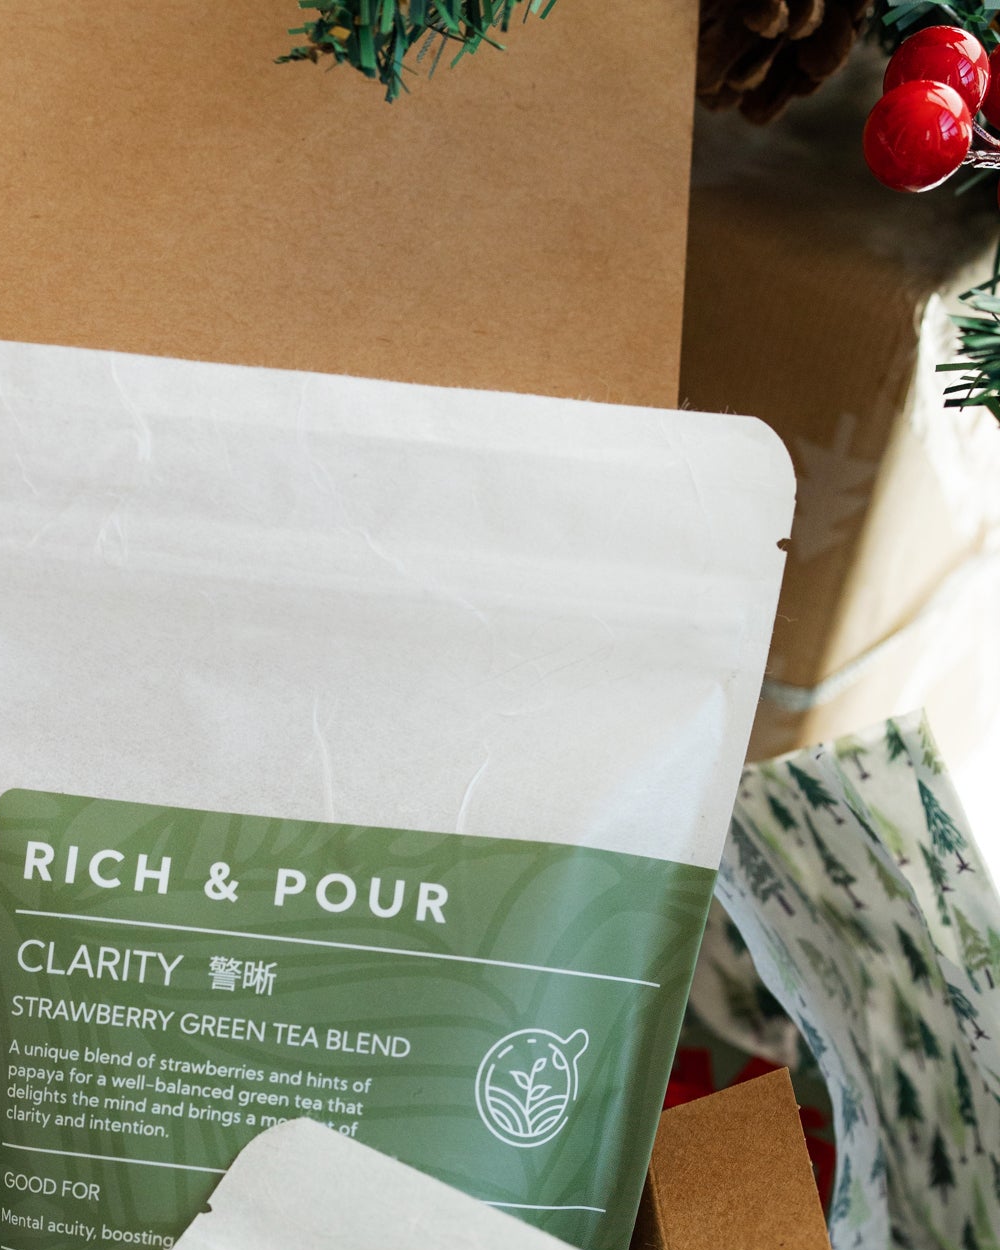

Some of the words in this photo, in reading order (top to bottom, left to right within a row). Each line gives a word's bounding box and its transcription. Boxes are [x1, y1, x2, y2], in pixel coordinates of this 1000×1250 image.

[23, 840, 172, 895] RICH
[204, 861, 240, 903] &
[273, 867, 449, 924] POUR
[16, 938, 185, 987] CLARITY
[208, 955, 278, 996] 警晰
[11, 994, 176, 1032] STRAWBERRY
[179, 1012, 266, 1042] GREEN
[272, 1022, 319, 1049] TEA
[325, 1028, 411, 1058] BLEND
[8, 1039, 20, 1054] A
[24, 1043, 79, 1063] unique
[84, 1047, 133, 1067] blend
[136, 1053, 156, 1068] of
[160, 1057, 264, 1082] strawberries
[269, 1071, 302, 1086] and
[306, 1072, 348, 1092] hints
[352, 1078, 373, 1093] of
[8, 1064, 64, 1083] papaya
[69, 1068, 93, 1084] for
[97, 1075, 107, 1086] a
[112, 1074, 235, 1101] well-balanced
[238, 1090, 289, 1107] green
[295, 1095, 323, 1110] tea
[328, 1097, 364, 1116] that
[6, 1105, 51, 1128] clarity
[55, 1113, 85, 1129] and
[90, 1115, 170, 1138] intention.
[7, 1083, 67, 1105] delights
[72, 1091, 100, 1108] the
[104, 1095, 147, 1113] mind
[151, 1102, 184, 1118] and
[188, 1103, 241, 1127] brings
[246, 1114, 256, 1126] a
[339, 1122, 359, 1137] of
[3, 1171, 57, 1195] GOOD
[62, 1180, 100, 1201] FOR
[1, 1207, 44, 1230] Mental
[47, 1219, 98, 1241] acuity,
